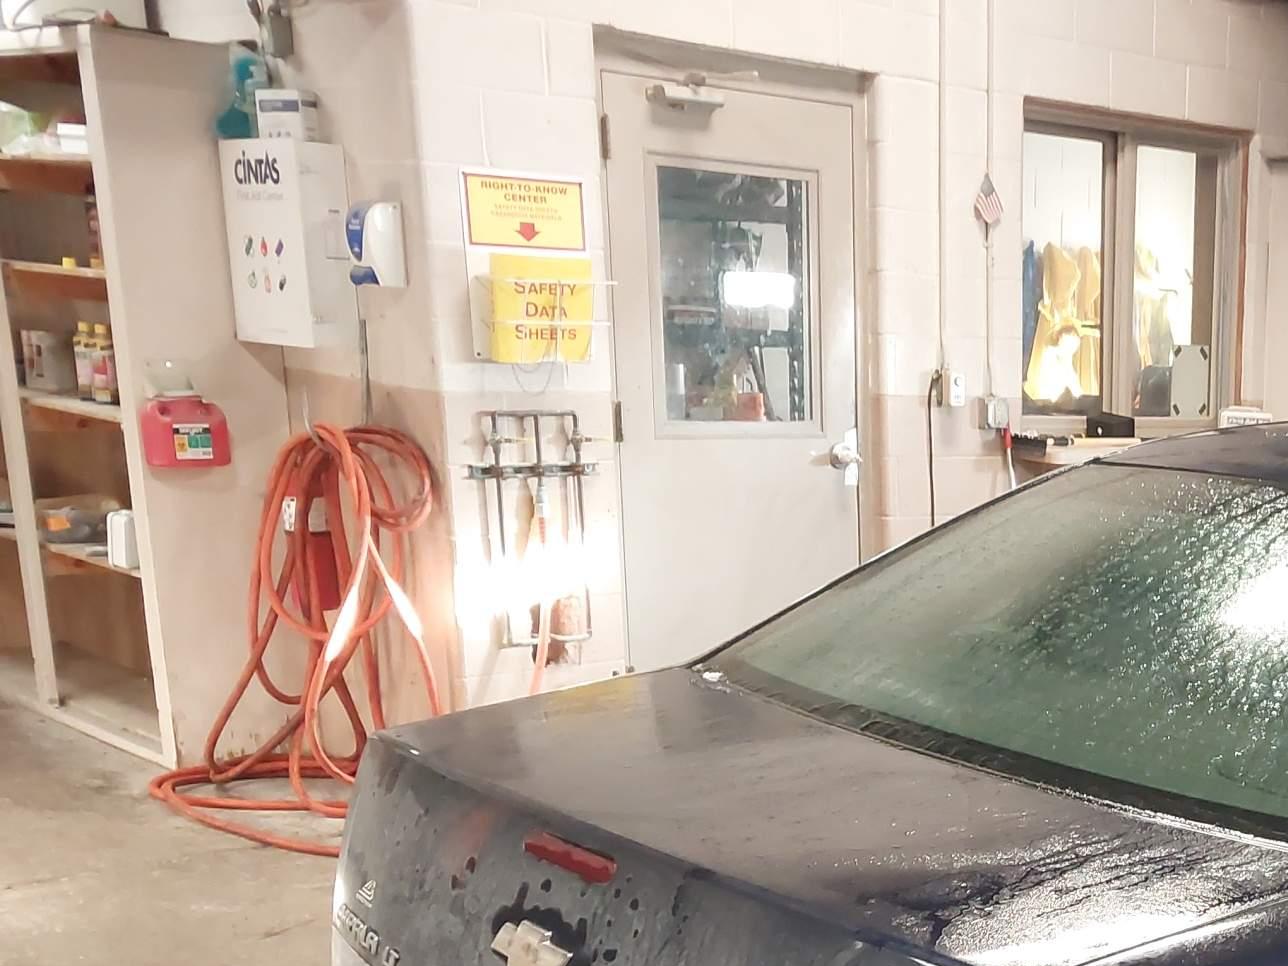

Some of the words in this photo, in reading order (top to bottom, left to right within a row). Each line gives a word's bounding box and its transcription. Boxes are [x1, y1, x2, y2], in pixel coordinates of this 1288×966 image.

[234, 149, 280, 185] CINTAS
[480, 180, 568, 195] RIGHT-TO-KNOW
[504, 193, 547, 204] CENTER
[514, 281, 577, 296] SAFETY
[525, 301, 568, 318] DATA
[515, 324, 577, 340] SHEETS
[336, 904, 380, 956] MPALA
